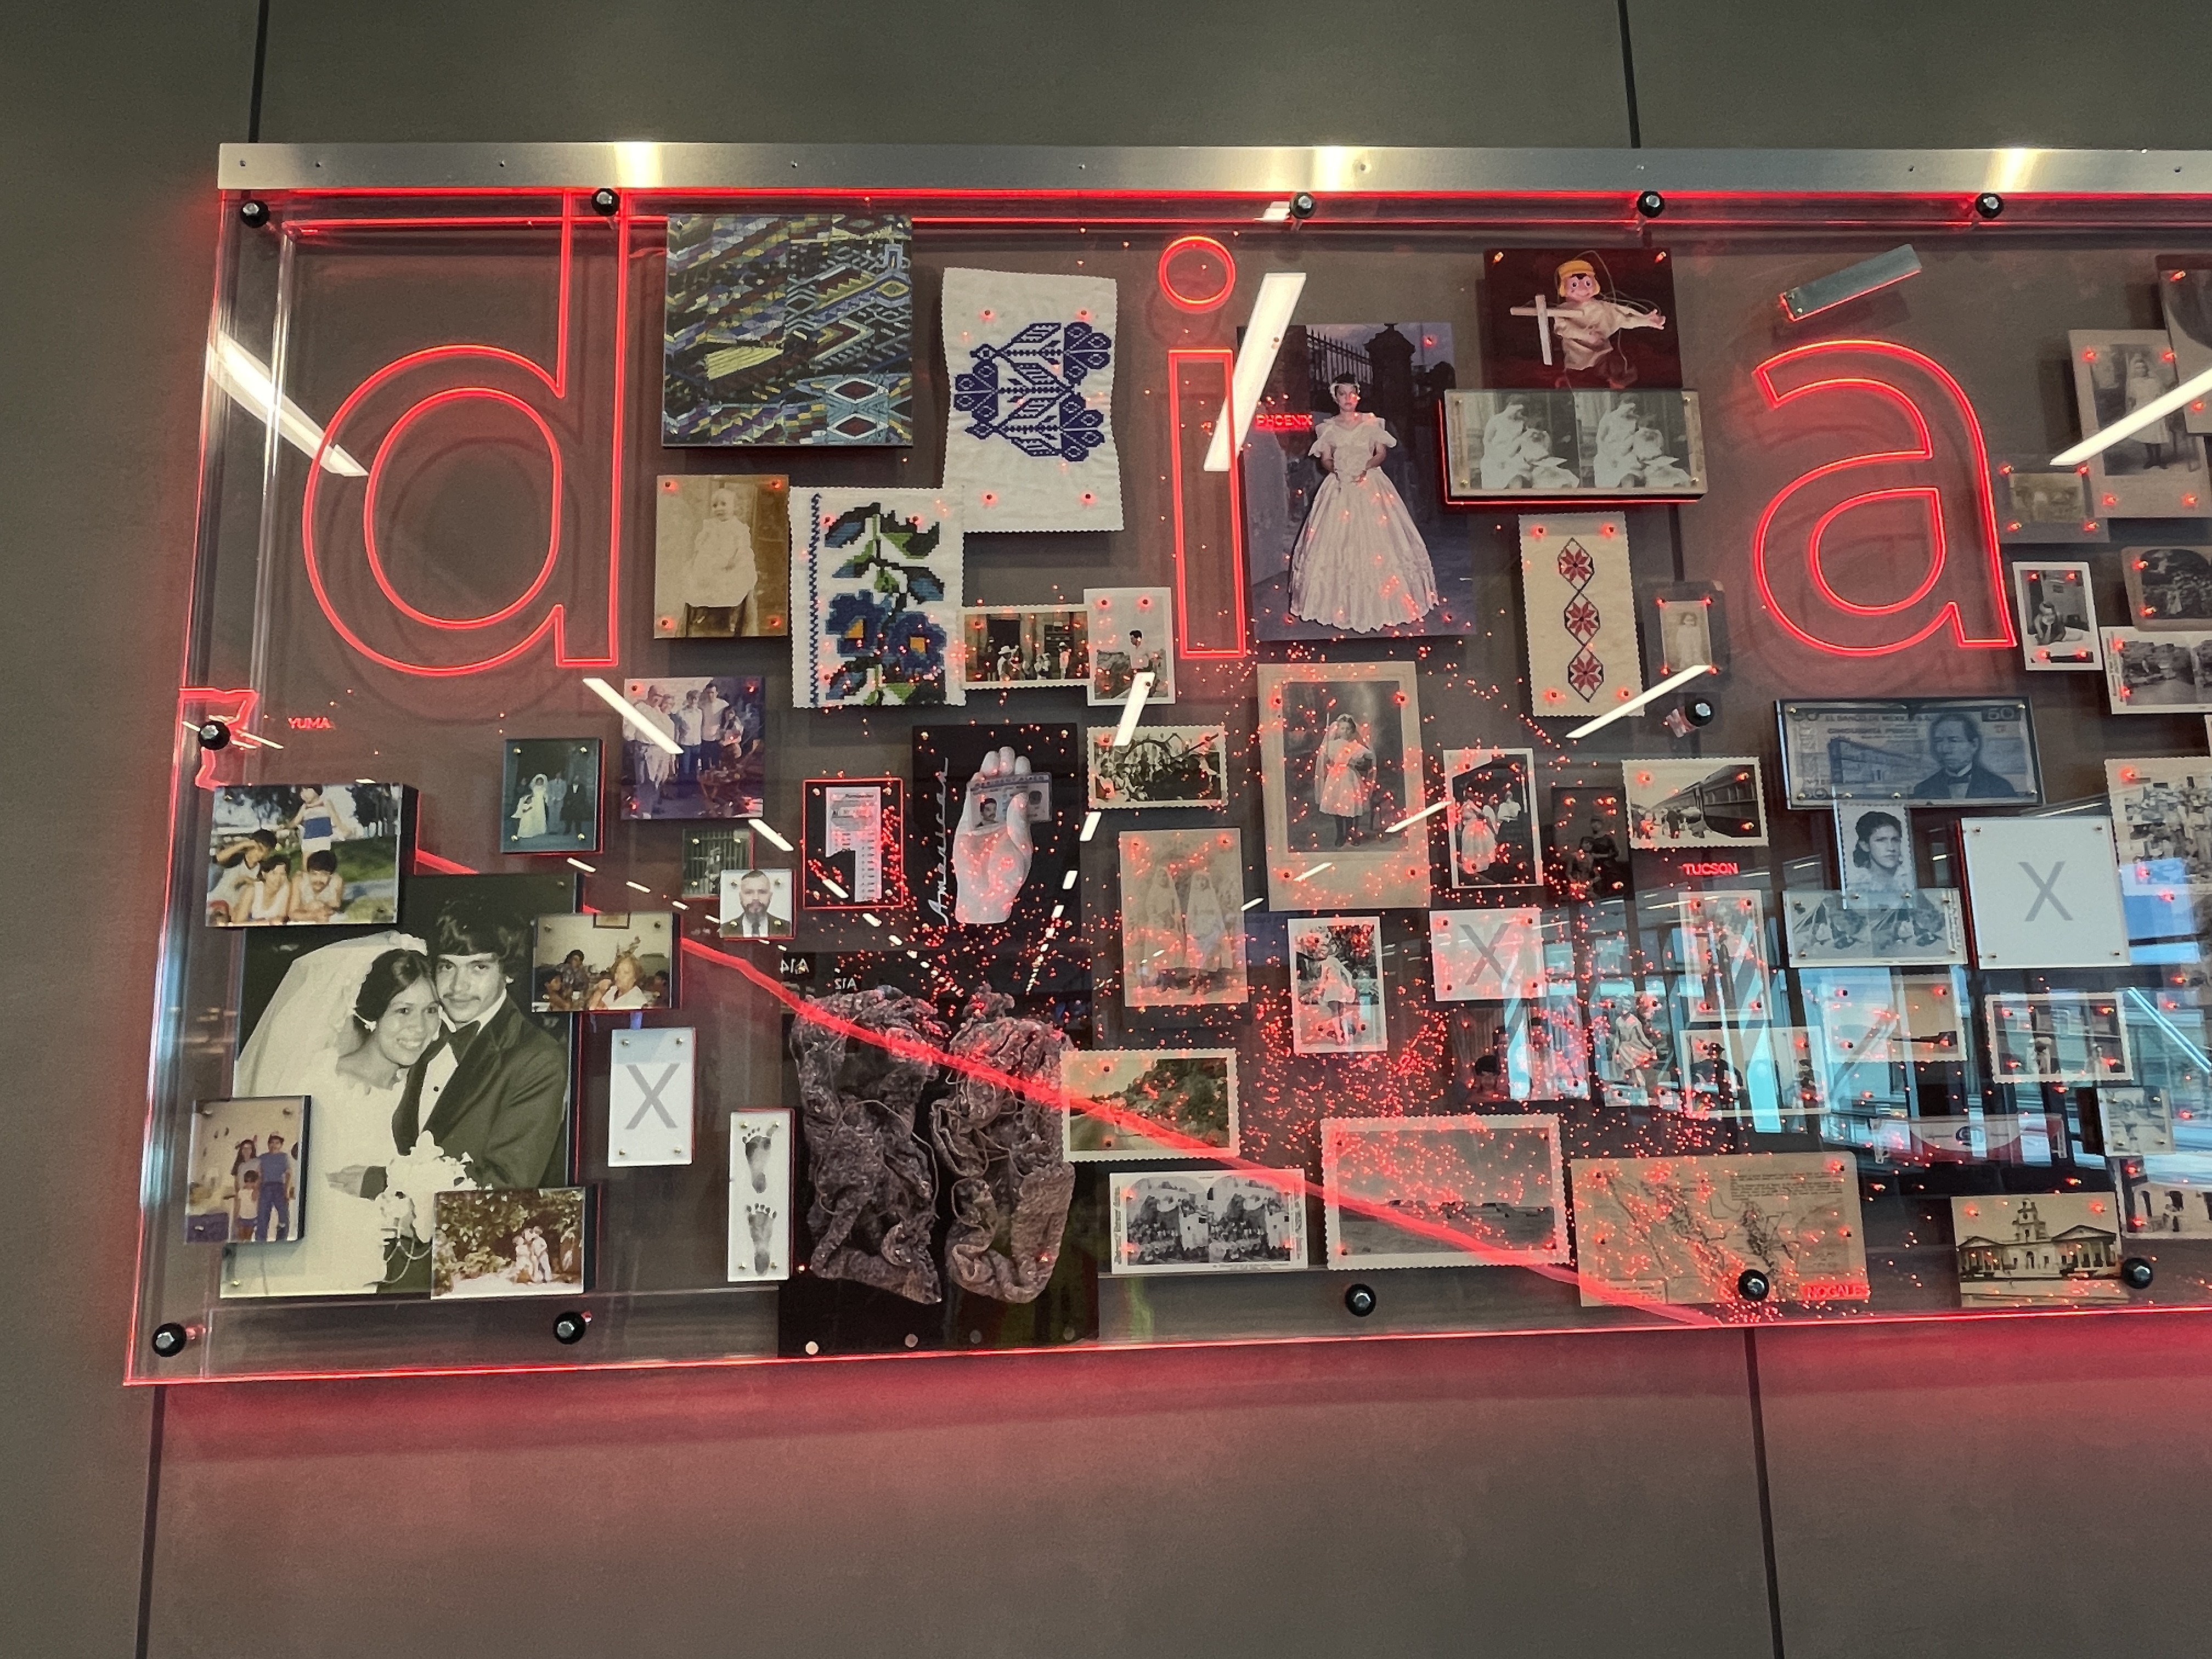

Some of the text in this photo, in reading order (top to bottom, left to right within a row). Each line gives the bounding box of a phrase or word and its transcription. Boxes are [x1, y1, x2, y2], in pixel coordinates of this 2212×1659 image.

[1256, 414, 1313, 426] PHOENIX
[1987, 707, 2015, 720] 50
[287, 717, 331, 729] YUMA
[927, 757, 950, 926] American
[1682, 862, 1739, 876] TUCSON
[2018, 861, 2074, 922] X
[1459, 923, 1515, 986] X
[625, 1064, 680, 1130] X
[1807, 1285, 1872, 1299] NOGALES
